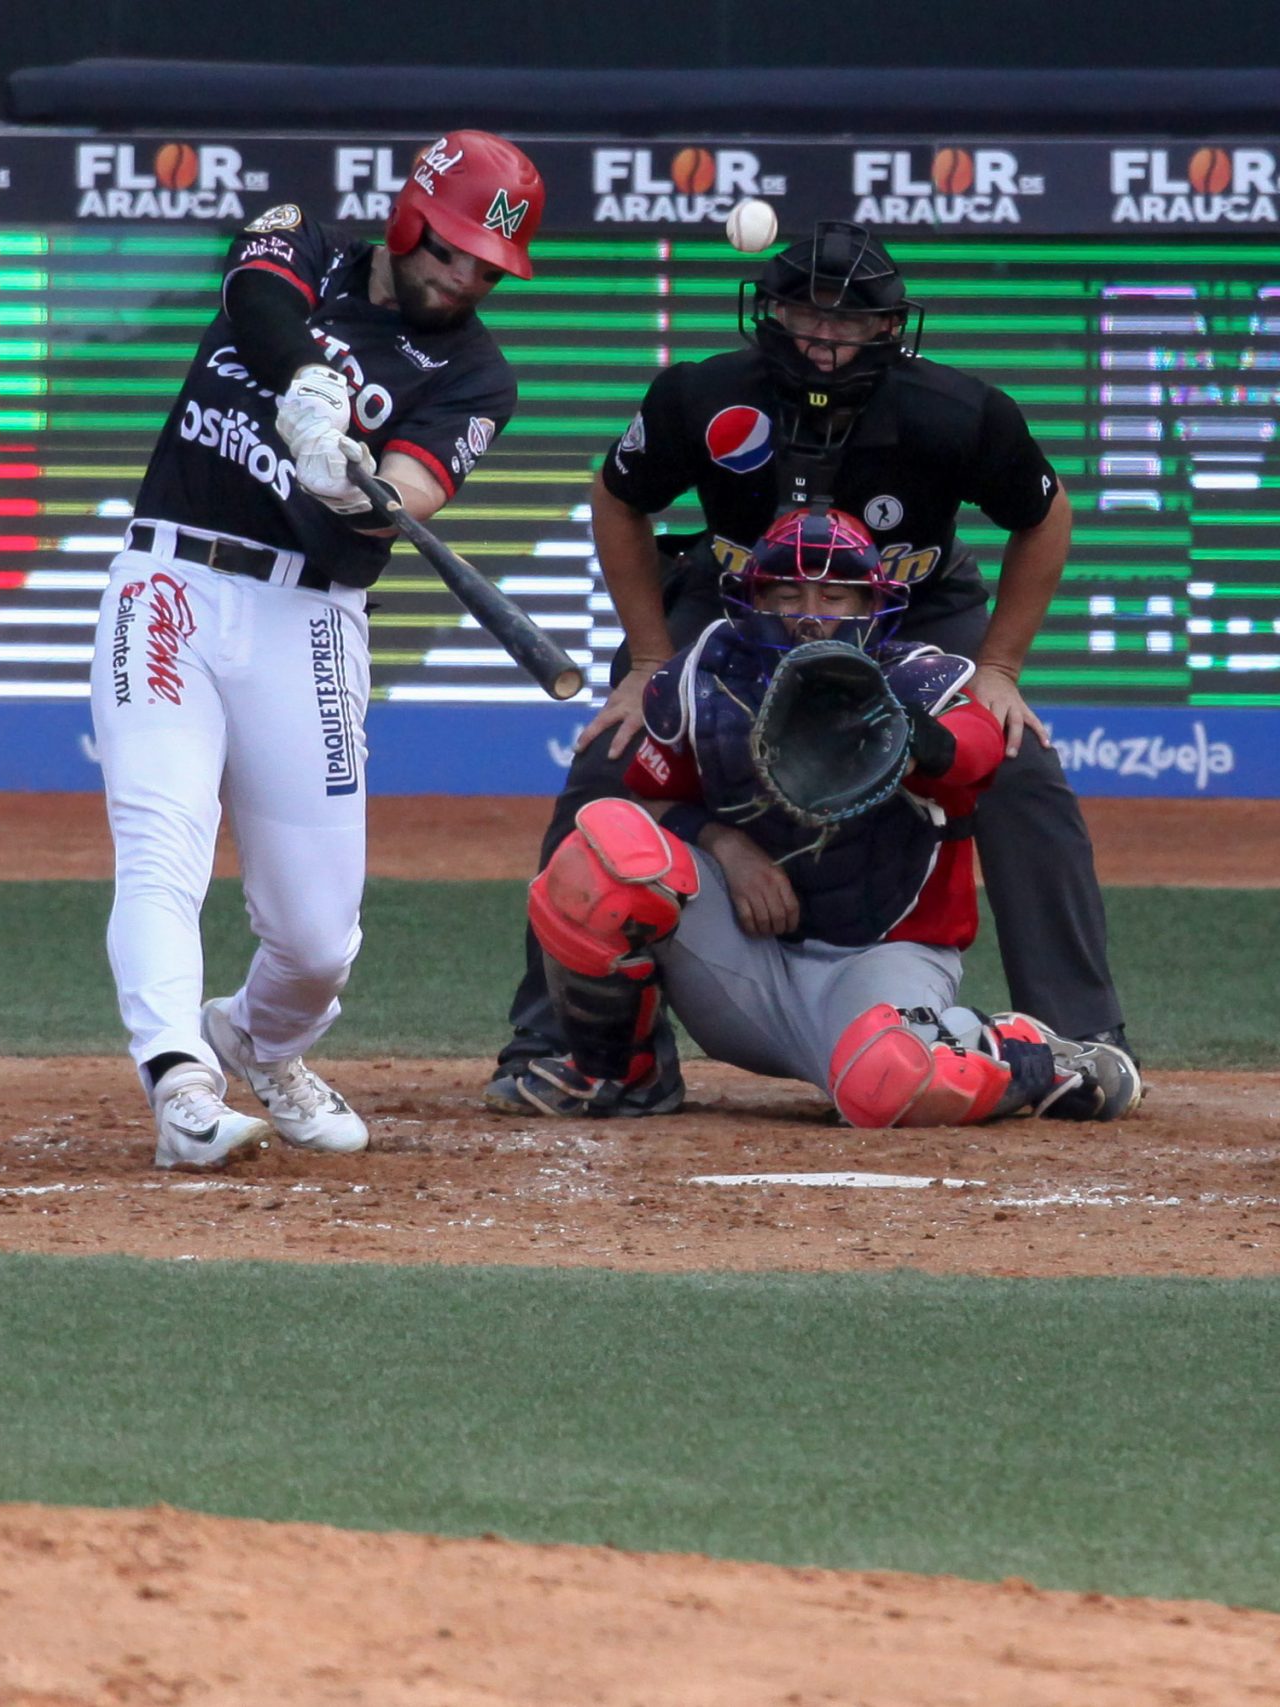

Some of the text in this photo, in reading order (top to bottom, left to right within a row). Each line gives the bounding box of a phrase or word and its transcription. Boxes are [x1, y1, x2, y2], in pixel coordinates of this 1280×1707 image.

[76, 143, 241, 190] FLOR
[422, 137, 463, 176] Red
[593, 148, 760, 194] FLOR
[853, 148, 1019, 194] FLOR
[1111, 148, 1276, 194] FLOR
[77, 191, 241, 219] ARAUCA
[854, 196, 1019, 223] ARAUCA
[1112, 196, 1276, 222] ARAUCA
[113, 596, 136, 707] caliente.mx
[310, 618, 347, 775] PAQUETEXPRESS
